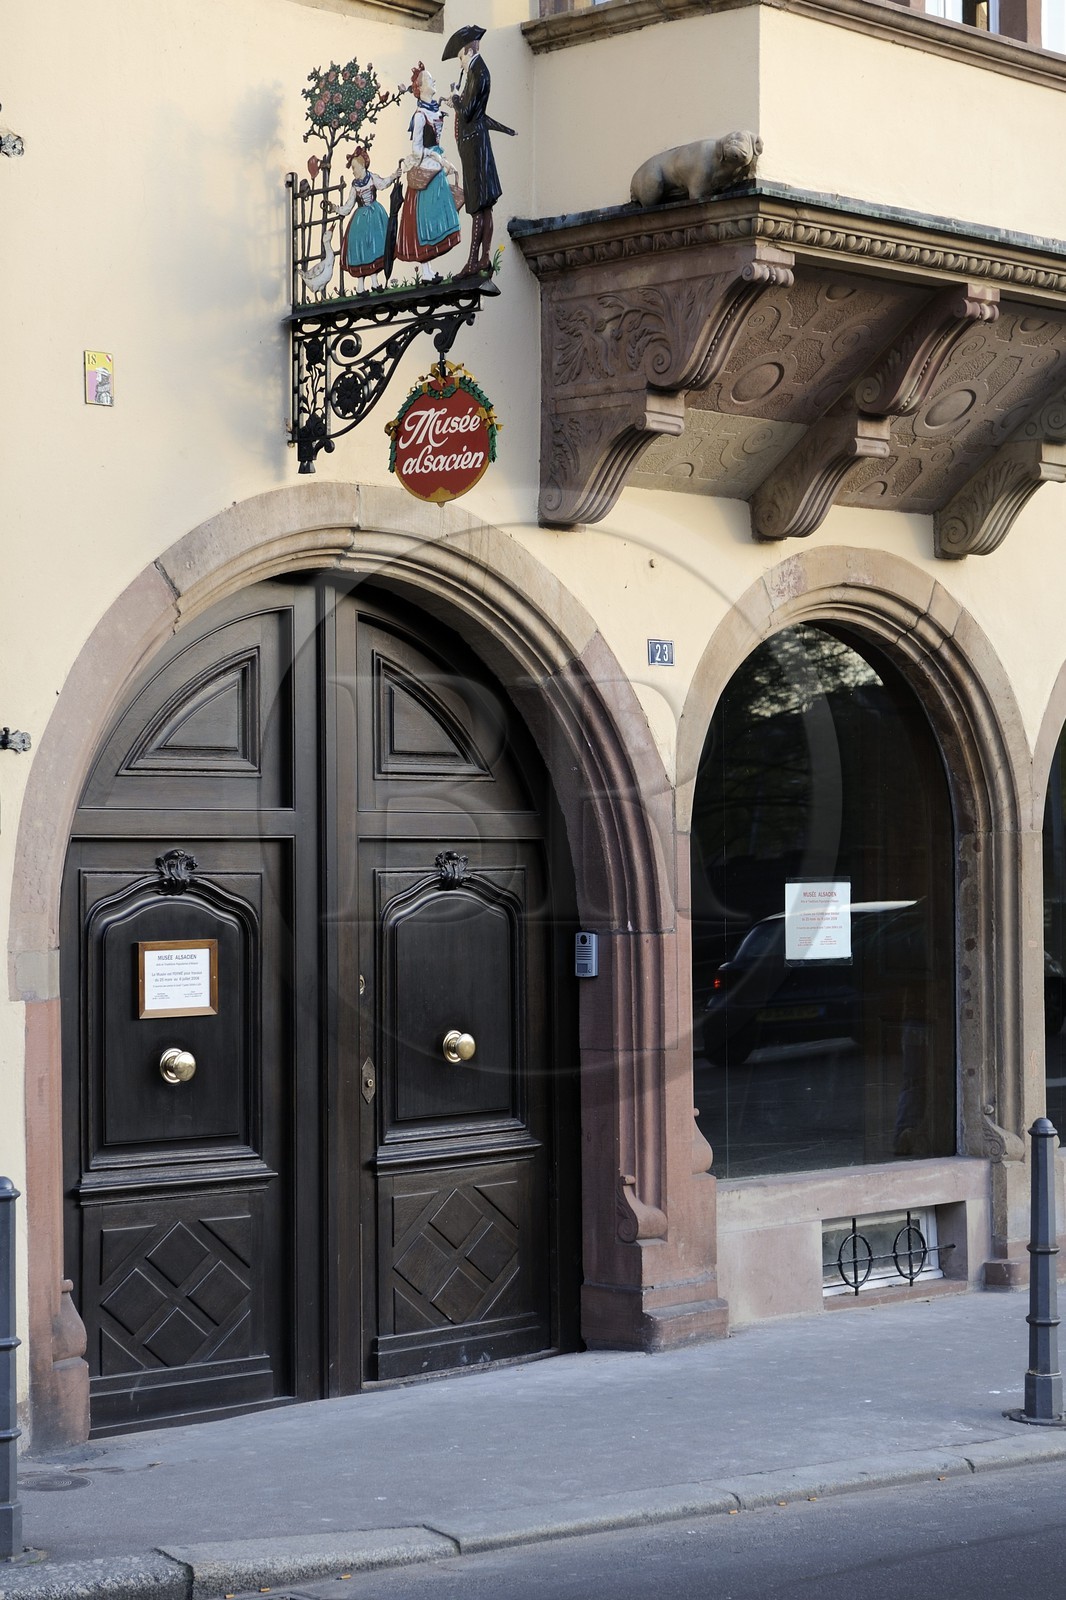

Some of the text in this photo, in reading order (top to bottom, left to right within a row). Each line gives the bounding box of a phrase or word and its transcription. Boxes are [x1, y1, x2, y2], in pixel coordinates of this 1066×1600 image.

[399, 407, 480, 449] Musée
[403, 445, 484, 475] alsacien
[656, 643, 668, 662] 23
